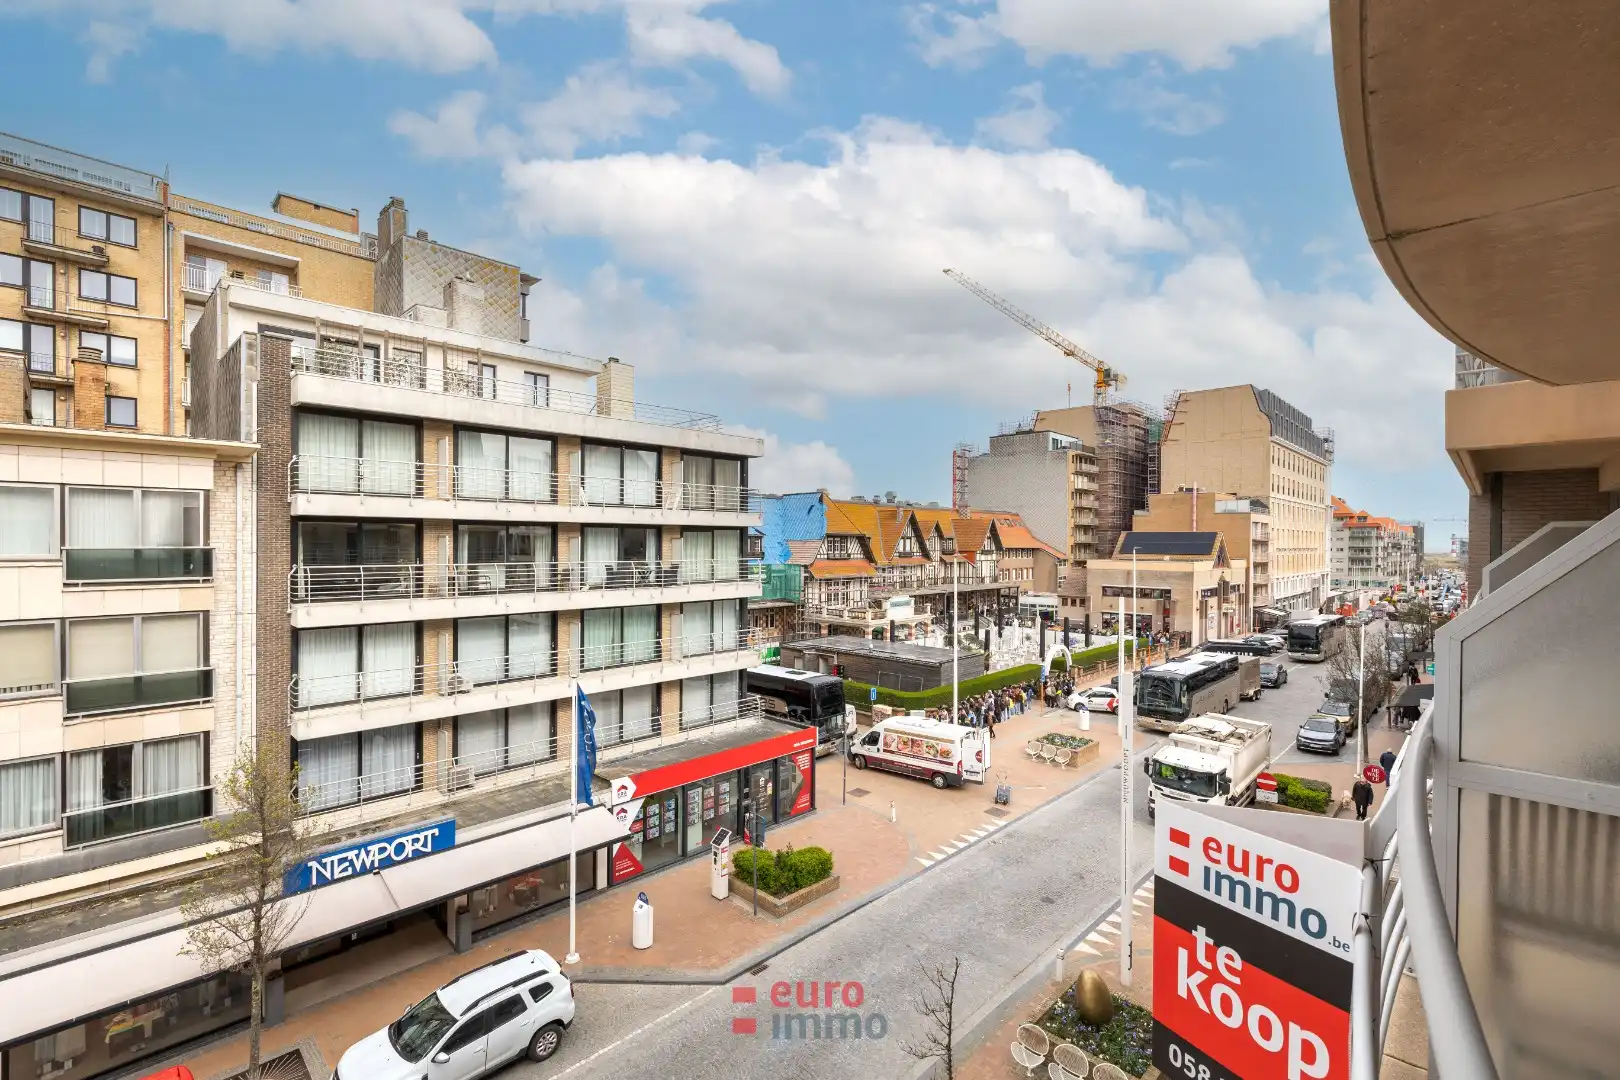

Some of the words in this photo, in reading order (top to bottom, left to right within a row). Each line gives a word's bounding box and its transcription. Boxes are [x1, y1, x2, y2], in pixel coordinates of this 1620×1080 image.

[307, 828, 439, 886] NEWPORT
[1202, 836, 1300, 894] euro
[1192, 924, 1243, 985] te
[1177, 946, 1330, 1080] koop
